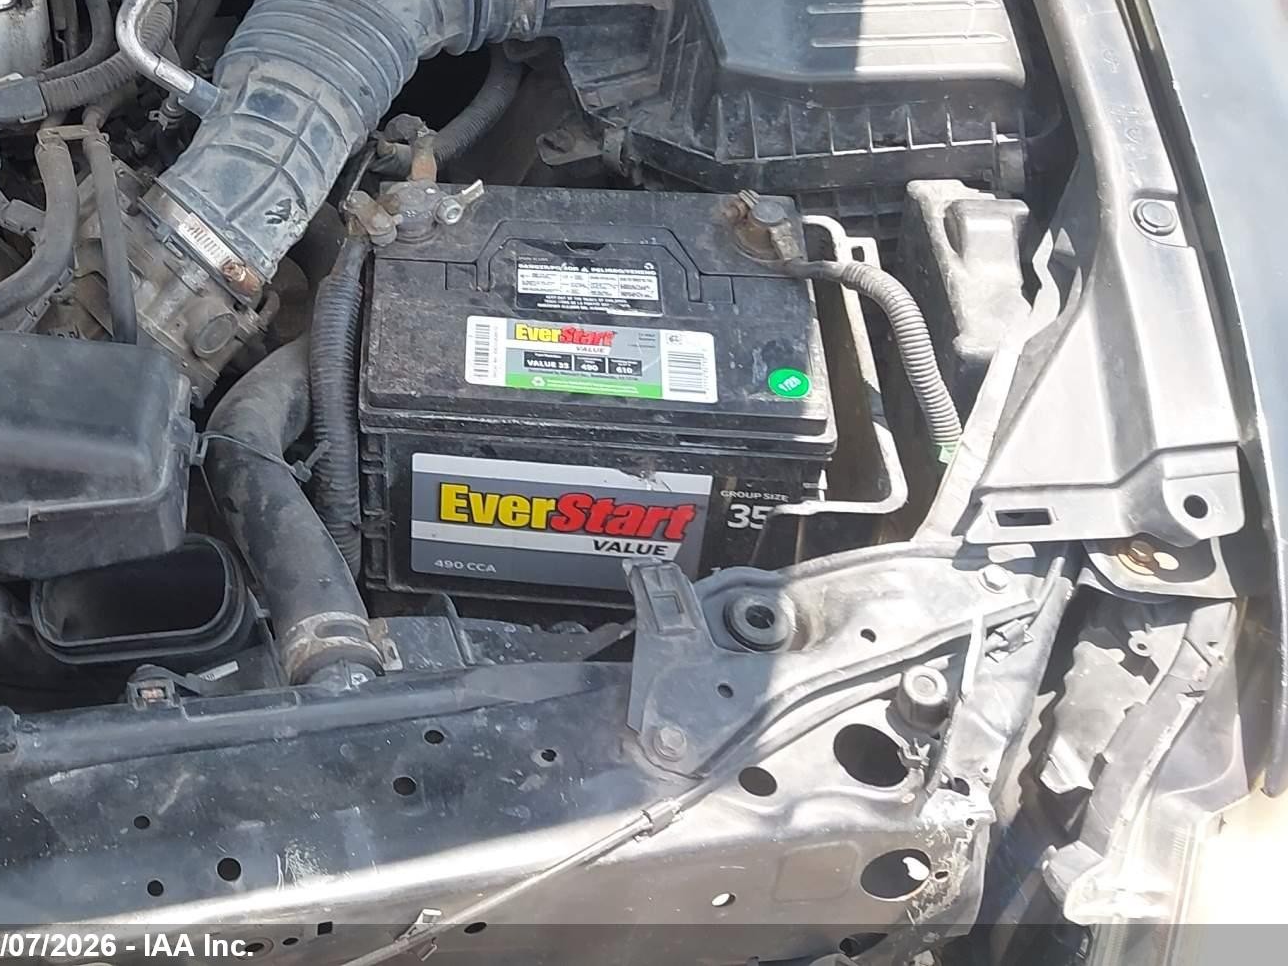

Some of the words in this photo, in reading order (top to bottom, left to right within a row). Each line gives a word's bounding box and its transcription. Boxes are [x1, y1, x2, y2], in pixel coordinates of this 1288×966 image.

[515, 323, 615, 347] EverStart
[576, 346, 605, 354] VALUE
[720, 490, 762, 500] GROUP
[763, 492, 789, 502] SIZE
[439, 482, 697, 541] EverStart
[727, 503, 774, 530] 35
[592, 539, 669, 556] VALUE
[434, 559, 464, 570] 490
[466, 562, 497, 573] CCA
